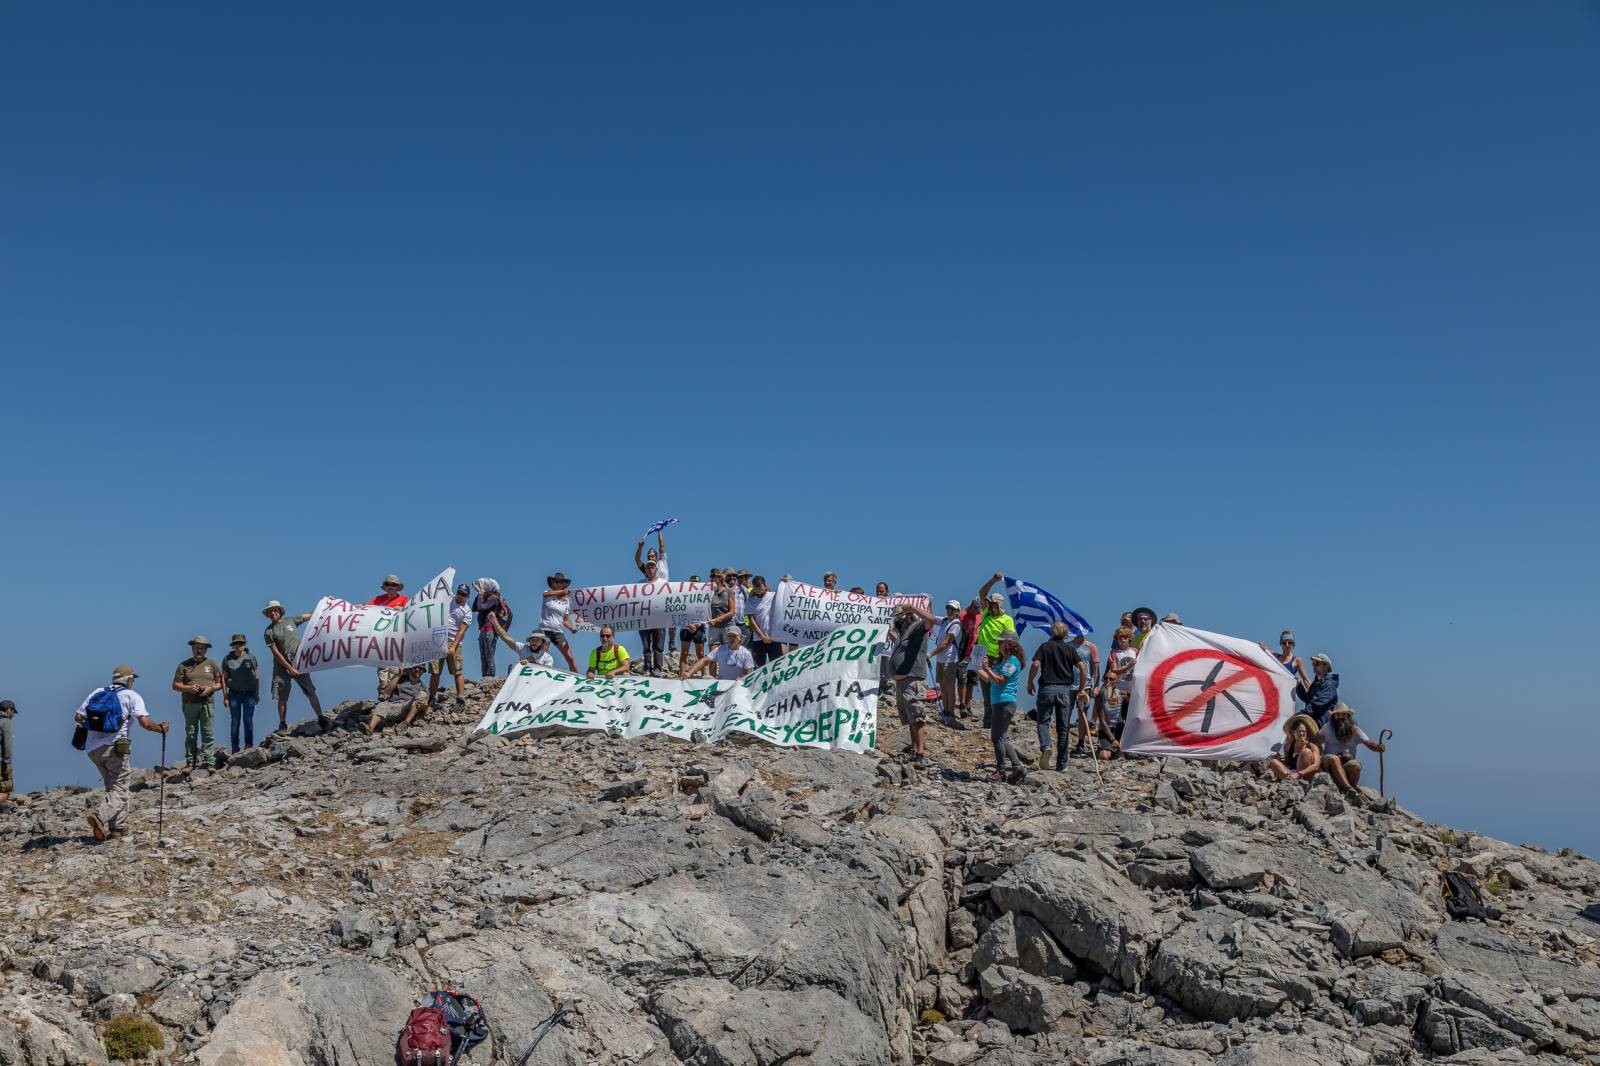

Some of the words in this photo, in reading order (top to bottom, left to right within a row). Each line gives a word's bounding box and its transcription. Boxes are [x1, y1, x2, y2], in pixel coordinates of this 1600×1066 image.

[665, 593, 711, 605] NATURA
[787, 595, 820, 610] ΣΤΗΝ
[848, 592, 872, 605] ΟΧΙ
[594, 600, 651, 621] ΘΡΥΠΤΗ
[784, 609, 831, 622] NATURA
[834, 612, 862, 625] 2000
[297, 635, 405, 670] MOUNTAIN
